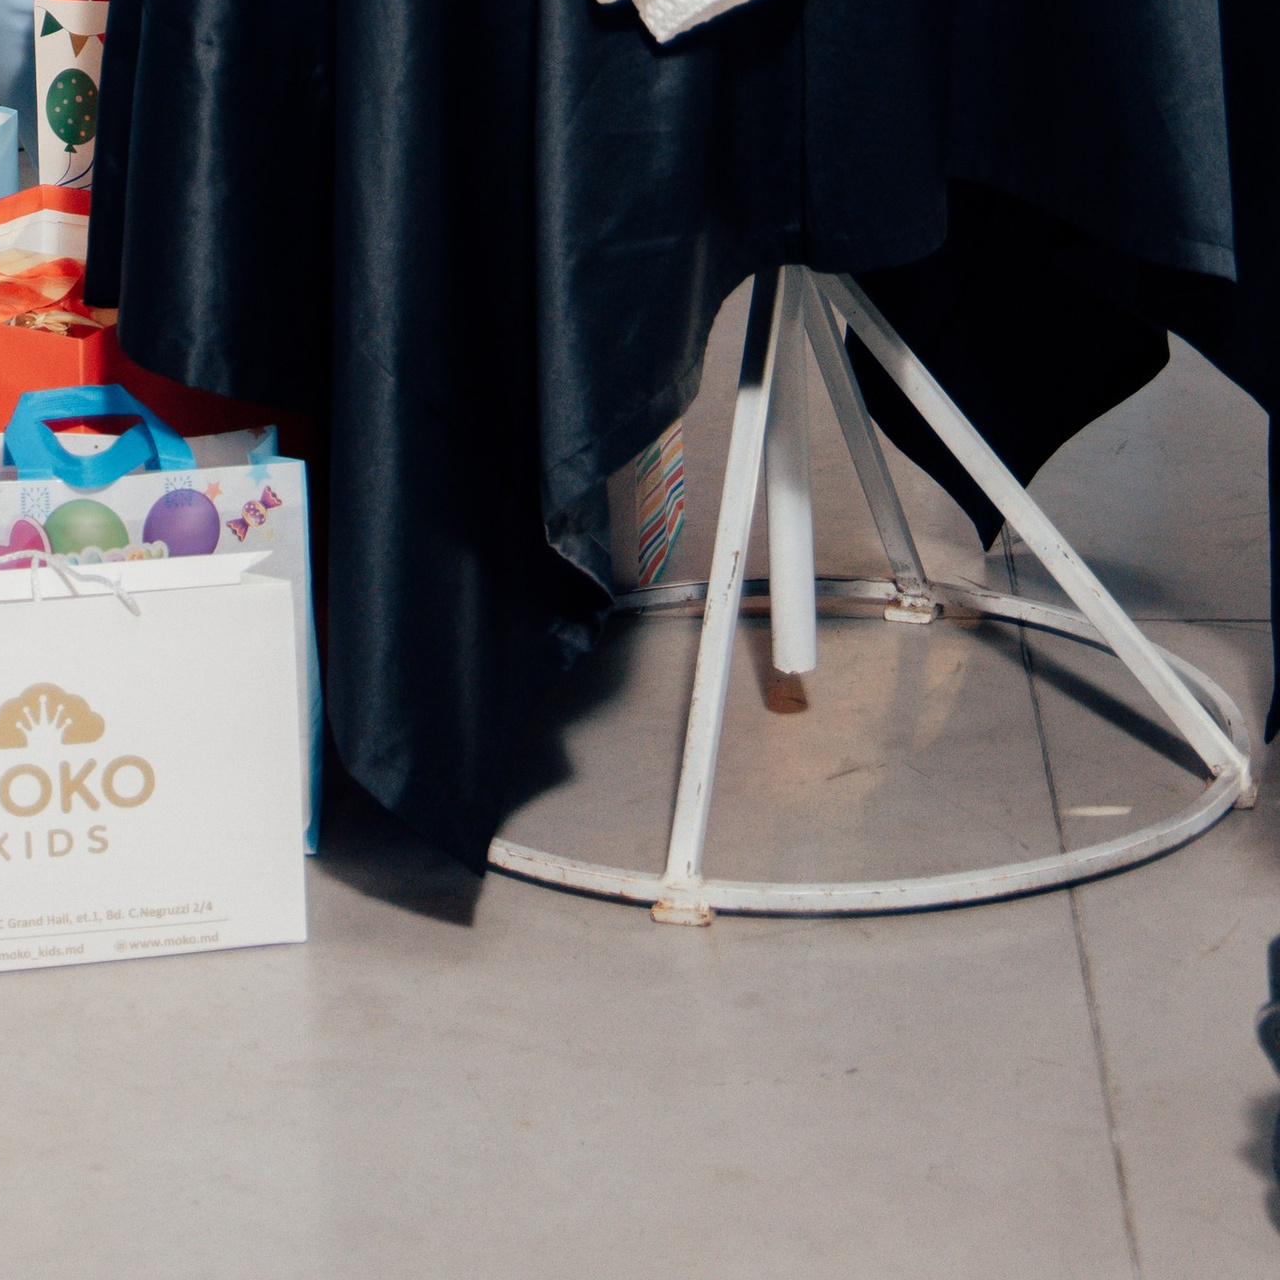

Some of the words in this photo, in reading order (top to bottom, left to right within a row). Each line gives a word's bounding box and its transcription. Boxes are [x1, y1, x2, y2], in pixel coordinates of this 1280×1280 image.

[7, 915, 44, 930] Grand
[128, 904, 190, 920] C.Negruzzi
[192, 900, 214, 914] 2/4
[129, 931, 220, 949] www.moko.md
